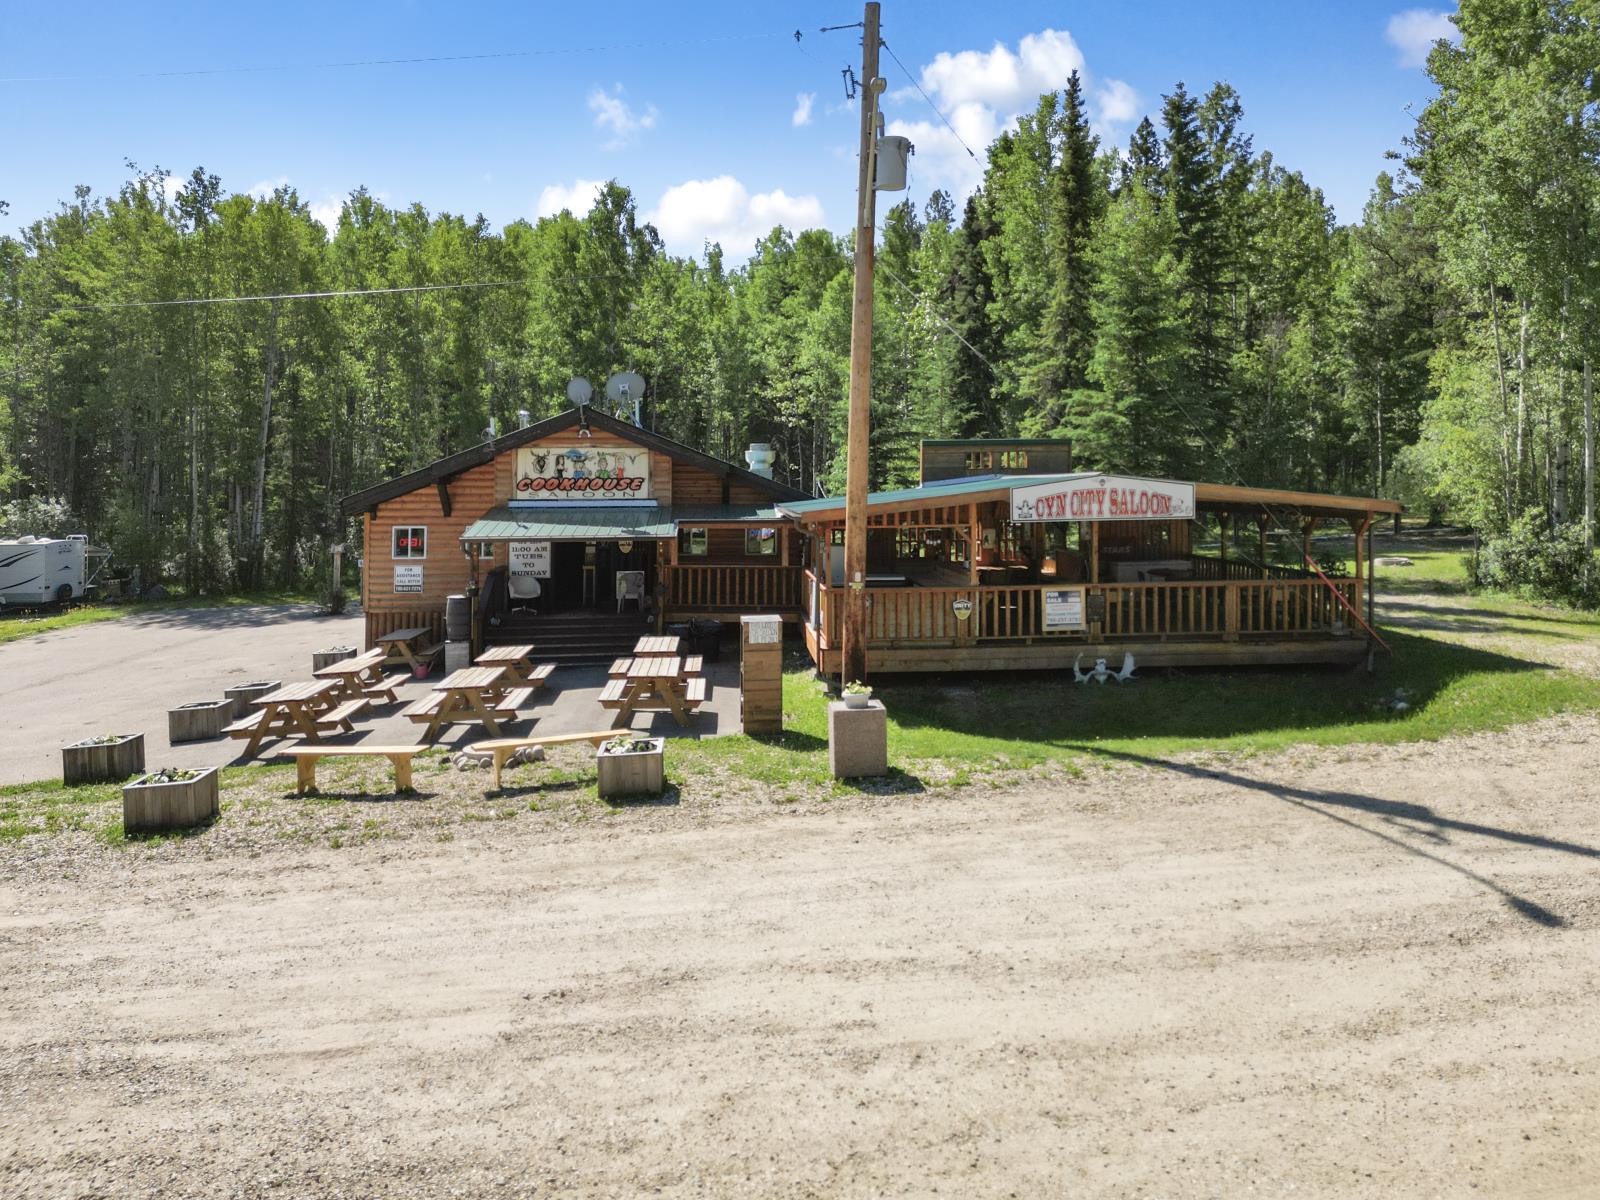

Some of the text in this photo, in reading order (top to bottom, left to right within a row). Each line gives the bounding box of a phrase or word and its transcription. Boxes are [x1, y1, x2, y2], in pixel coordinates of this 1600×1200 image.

[517, 477, 645, 491] COOKHOUSE
[1035, 488, 1173, 518] CYN CITY SALOON
